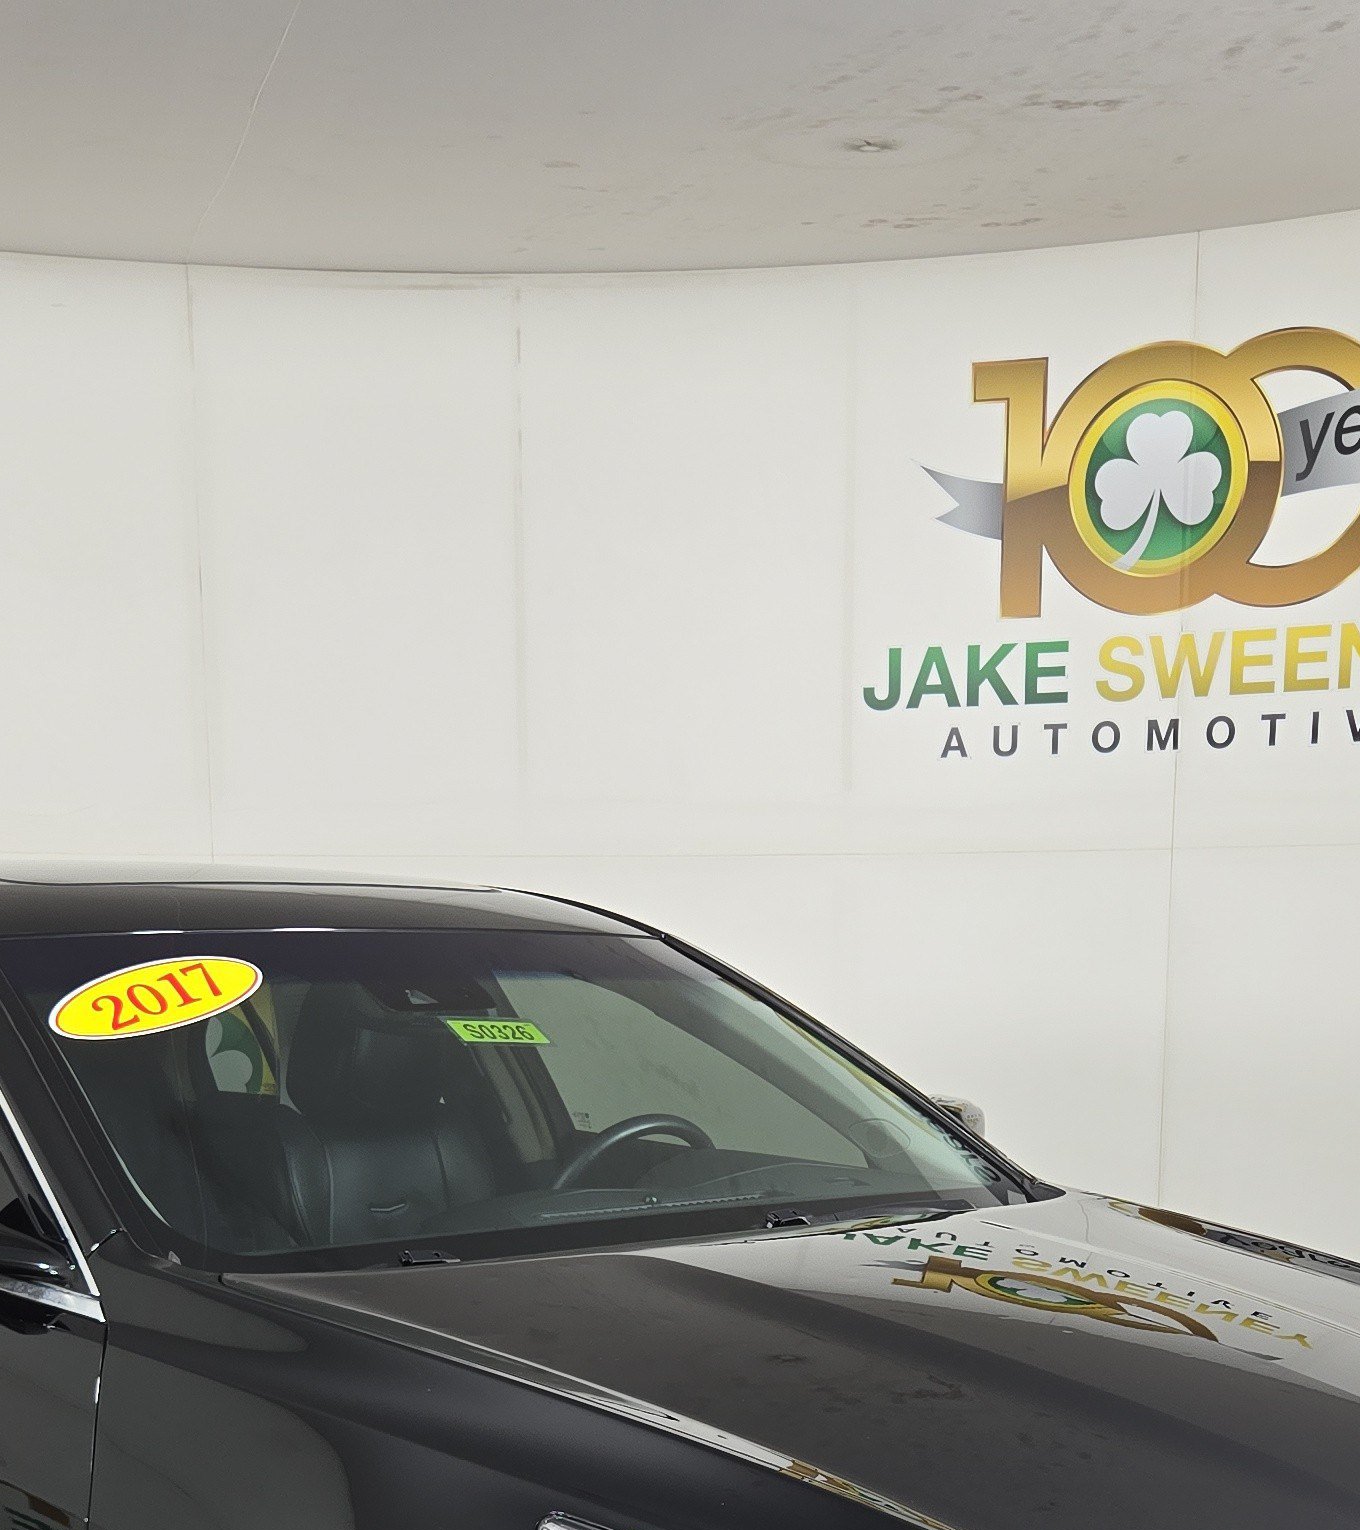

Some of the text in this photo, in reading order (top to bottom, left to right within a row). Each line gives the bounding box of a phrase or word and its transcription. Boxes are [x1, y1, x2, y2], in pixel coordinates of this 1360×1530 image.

[863, 640, 1069, 711] JAKE
[92, 963, 222, 1030] 2017
[463, 1023, 535, 1041] S0326
